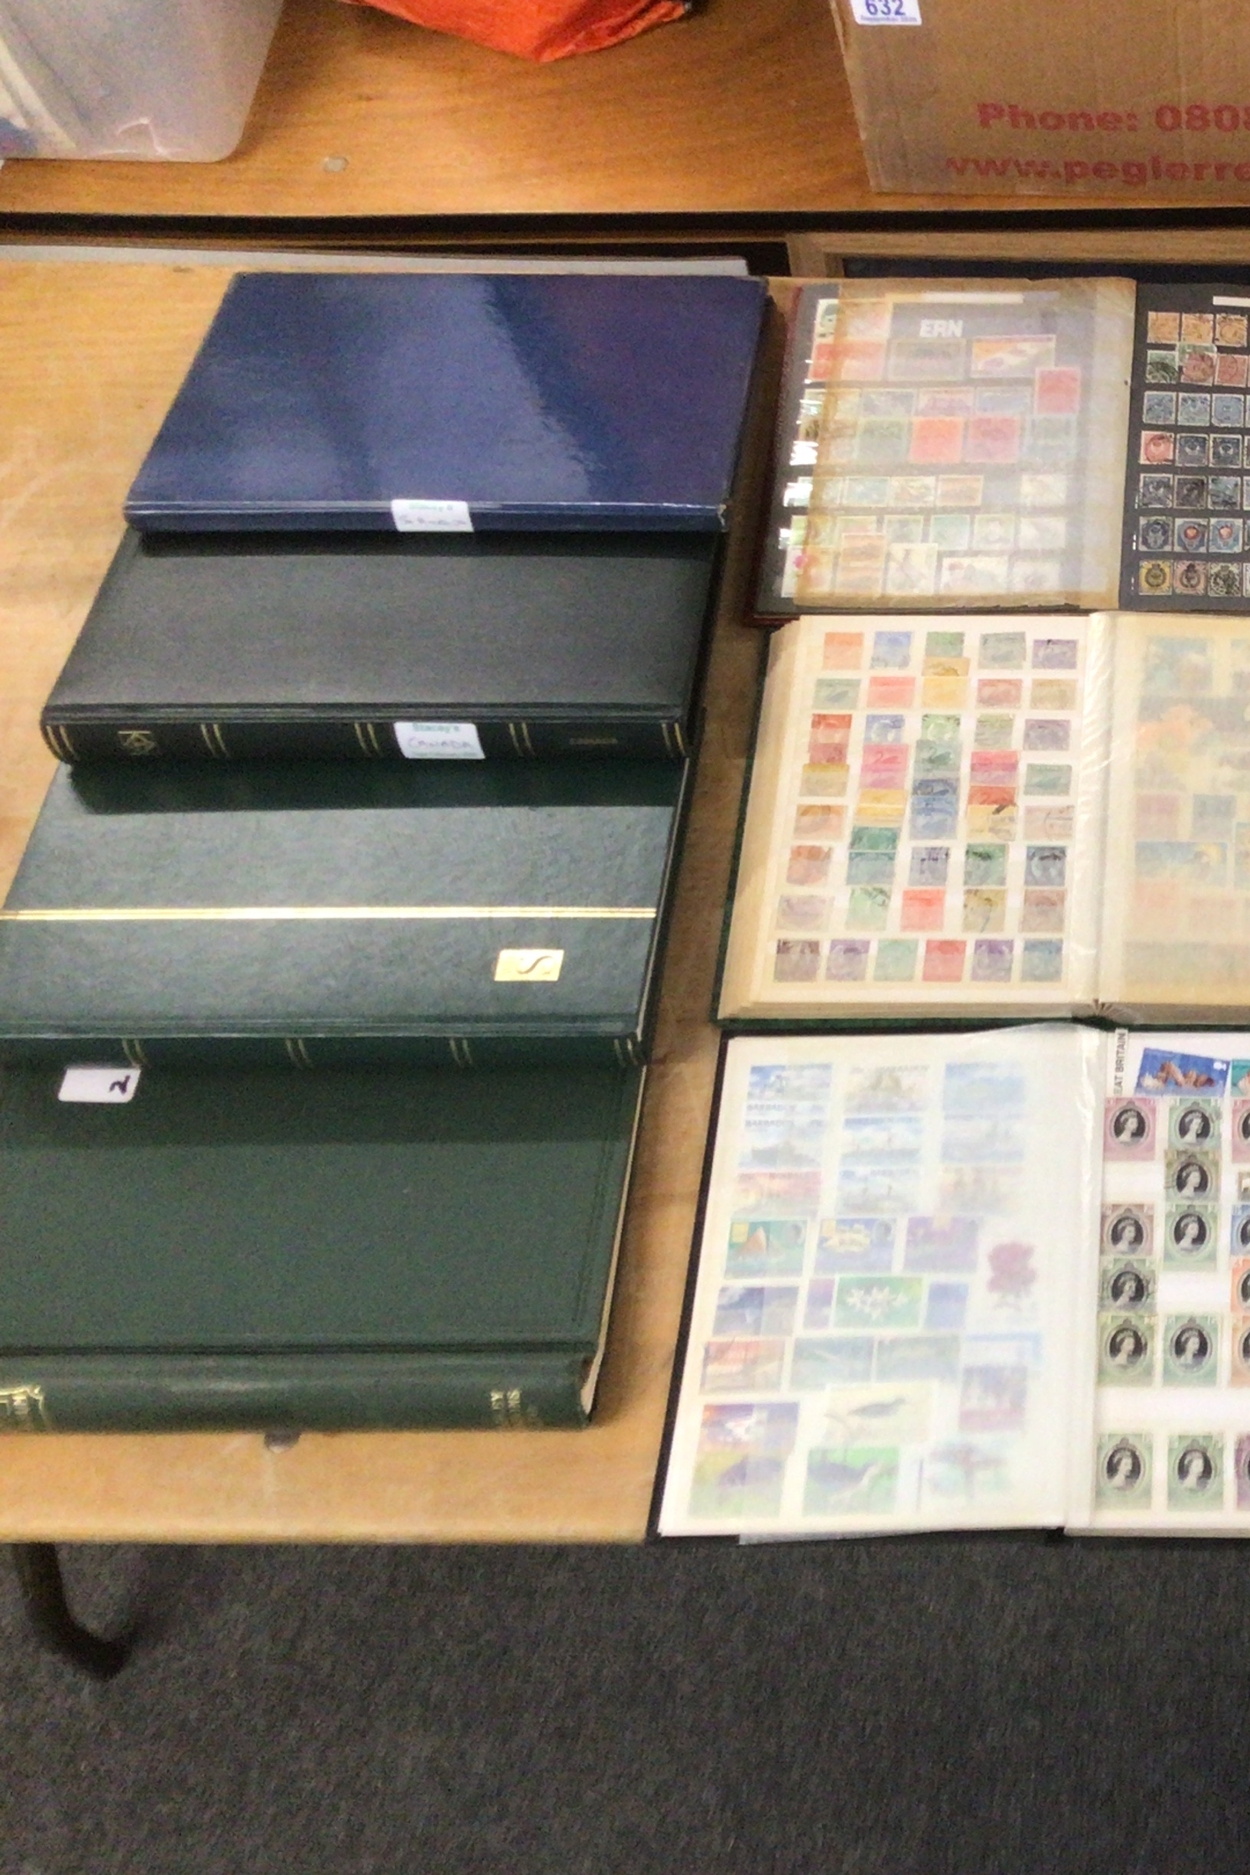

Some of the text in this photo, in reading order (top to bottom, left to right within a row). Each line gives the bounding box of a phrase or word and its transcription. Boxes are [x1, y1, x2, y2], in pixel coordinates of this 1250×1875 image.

[865, 0, 906, 15] 632
[977, 102, 1138, 132] Phone:
[1115, 1032, 1127, 1072] BRITAIN
